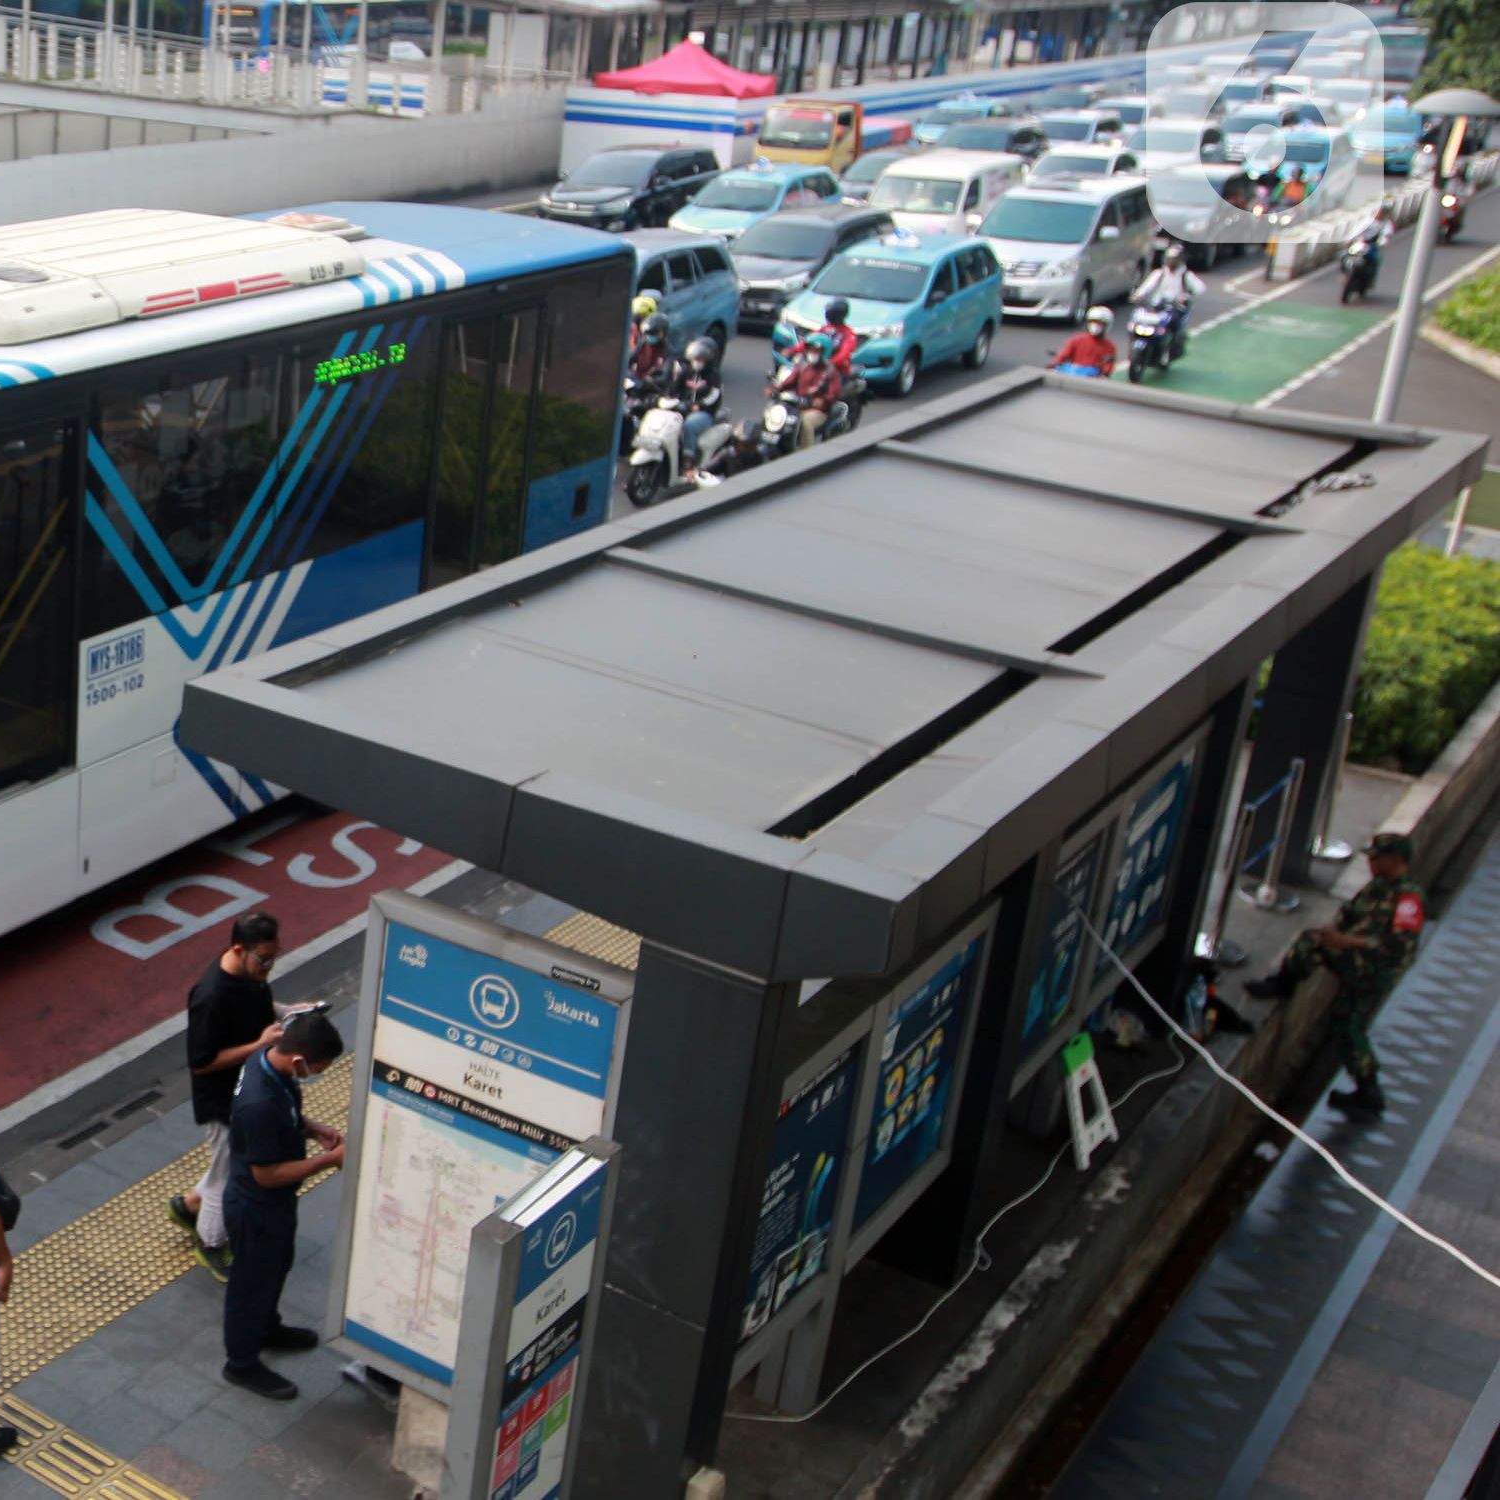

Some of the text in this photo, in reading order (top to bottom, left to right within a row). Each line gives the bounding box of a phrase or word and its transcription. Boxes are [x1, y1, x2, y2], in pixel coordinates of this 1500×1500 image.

[86, 674, 145, 707] 1500-102
[463, 1072, 504, 1100] Karet
[469, 1060, 501, 1081] HALTE
[438, 1090, 461, 1108] MRT
[461, 1099, 521, 1131] Bendungan
[520, 1124, 546, 1142] Hilir
[536, 1288, 566, 1325] Karet
